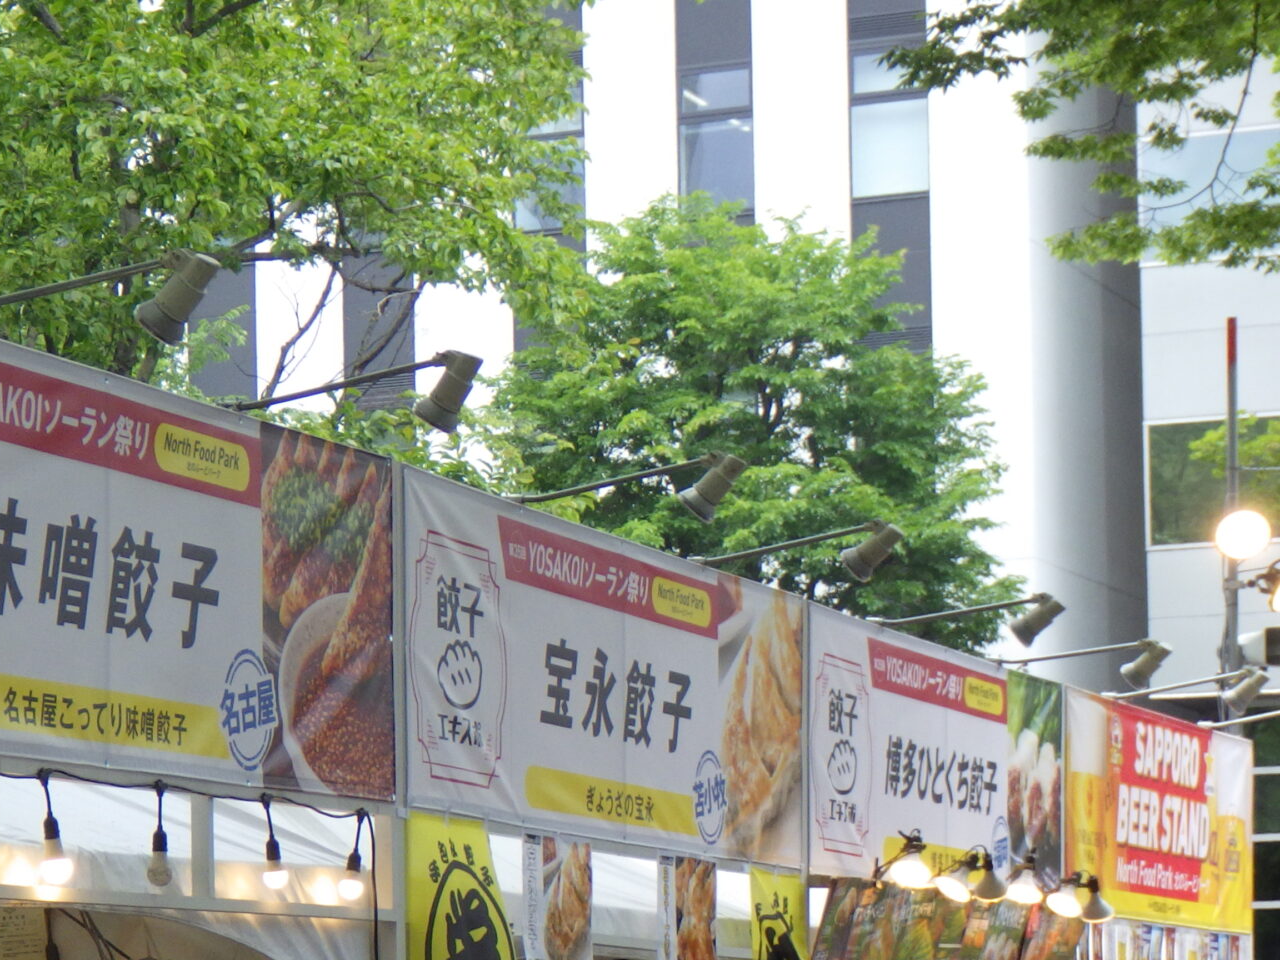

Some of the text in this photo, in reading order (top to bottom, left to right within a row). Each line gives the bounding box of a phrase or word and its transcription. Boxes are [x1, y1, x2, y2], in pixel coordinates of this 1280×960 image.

[163, 431, 240, 471] North Food Park
[528, 541, 650, 607] YOSAKOIソーラン祭り
[657, 582, 675, 602] North
[675, 587, 691, 608] Food
[691, 592, 705, 612] Park
[435, 574, 485, 638] 餃子
[3, 686, 189, 747] 名古屋こってり味噌餃子
[218, 679, 279, 738] 名古屋
[539, 638, 694, 753] 宝永餃子
[827, 688, 859, 737] 餃子
[885, 733, 999, 816] 博多ひとくち餃子
[1133, 720, 1201, 790] SAPPORO
[585, 785, 655, 822] ぎょうざの宝永
[1116, 782, 1211, 860] BEER STAND
